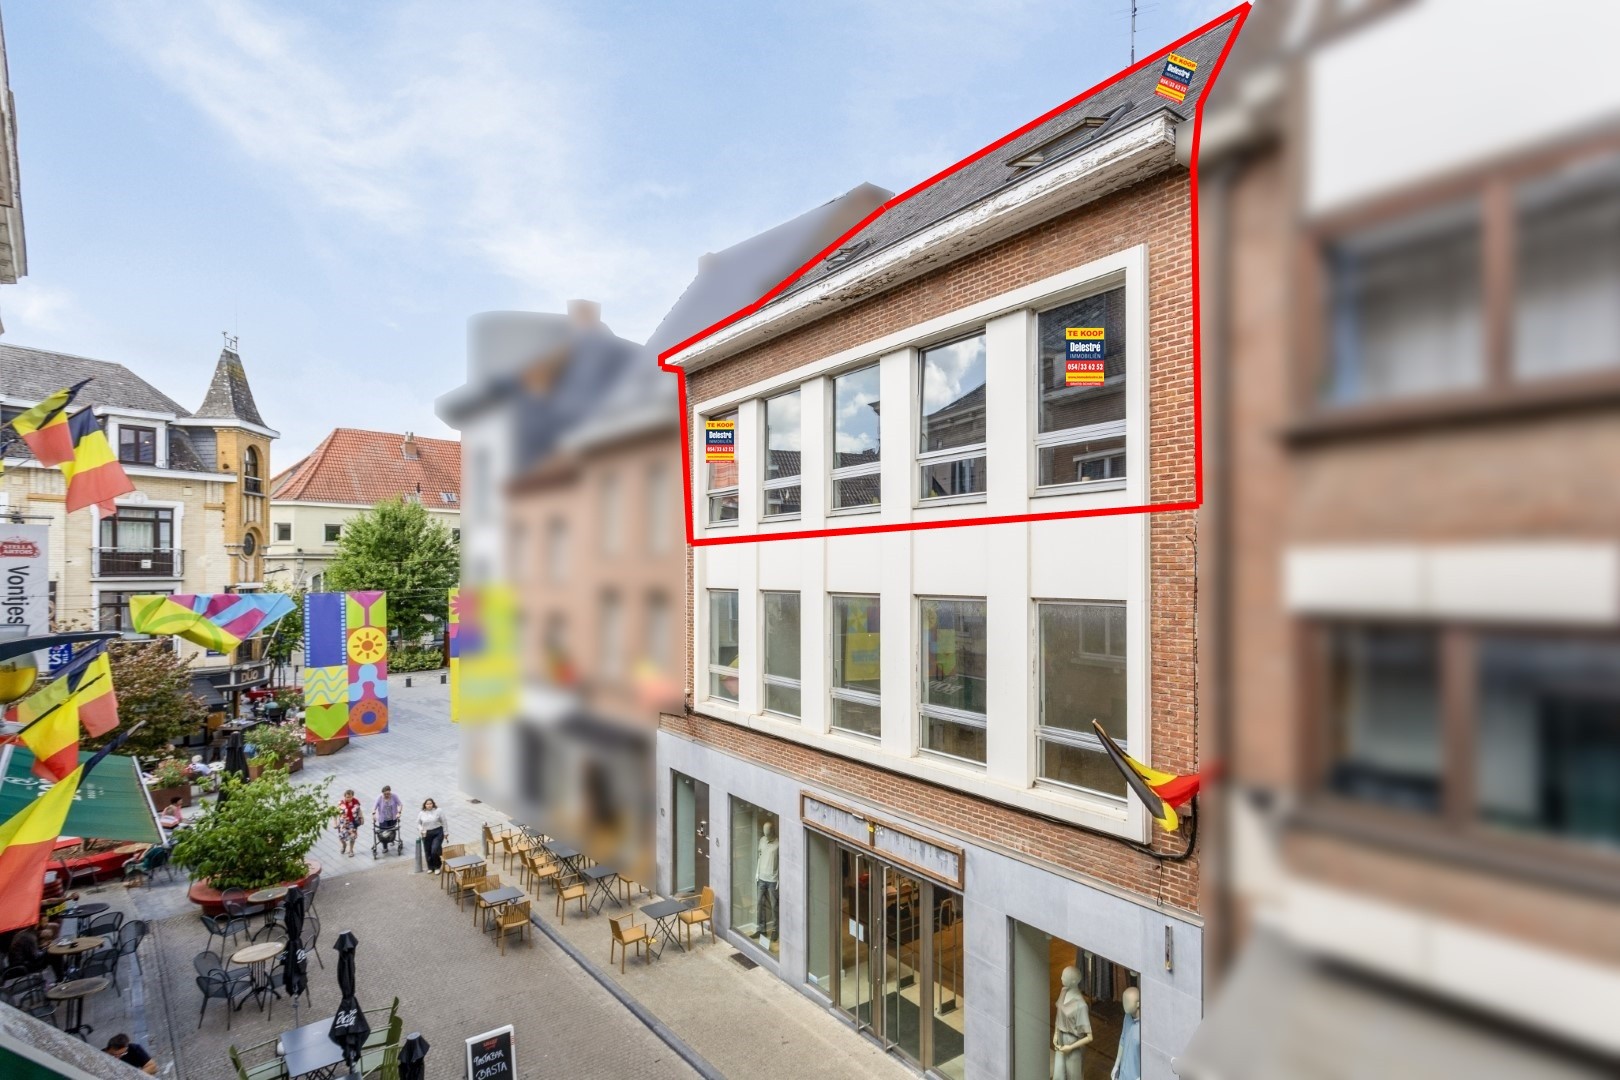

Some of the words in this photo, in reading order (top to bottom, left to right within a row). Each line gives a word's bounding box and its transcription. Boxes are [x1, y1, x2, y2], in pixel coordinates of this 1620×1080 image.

[1070, 342, 1101, 352] Delestré
[1067, 363, 1088, 371] 054/33
[709, 431, 732, 439] Delestré
[2, 565, 30, 624] Vontjes
